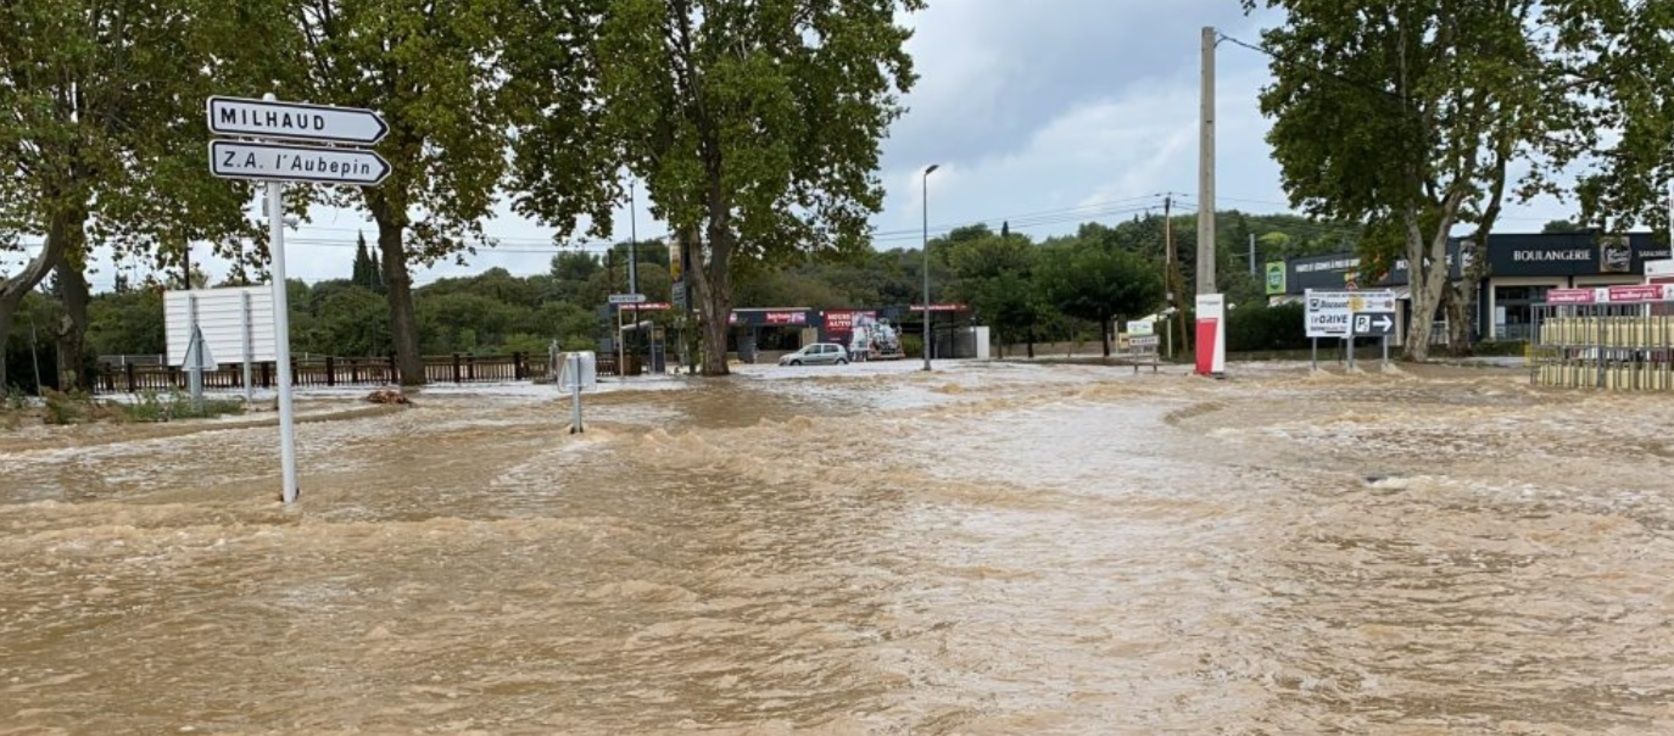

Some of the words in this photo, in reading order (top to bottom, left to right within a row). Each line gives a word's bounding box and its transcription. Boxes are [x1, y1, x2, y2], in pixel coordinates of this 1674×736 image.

[220, 107, 325, 131] MILHAUD
[223, 151, 264, 169] Z.A.
[275, 153, 370, 177] l'Aubepin
[1513, 249, 1591, 261] BOULANGERIE
